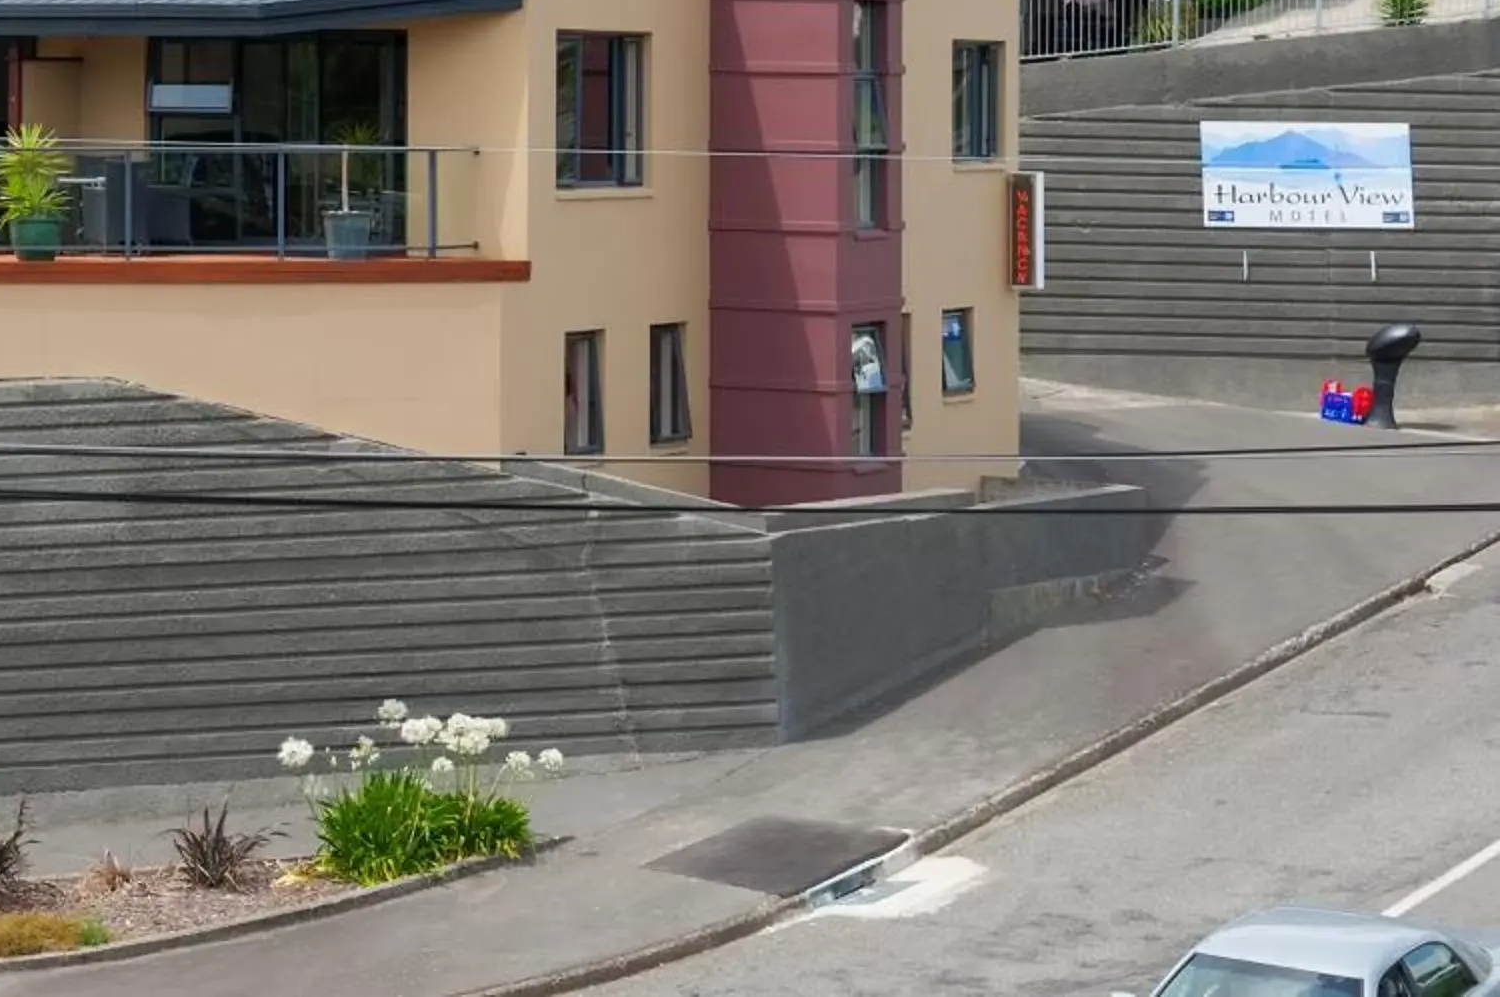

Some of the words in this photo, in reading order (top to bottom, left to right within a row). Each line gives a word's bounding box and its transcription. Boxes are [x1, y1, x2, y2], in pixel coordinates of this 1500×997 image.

[1214, 183, 1332, 205] Harbour
[1337, 184, 1405, 205] View
[1269, 209, 1348, 223] MOTEL
